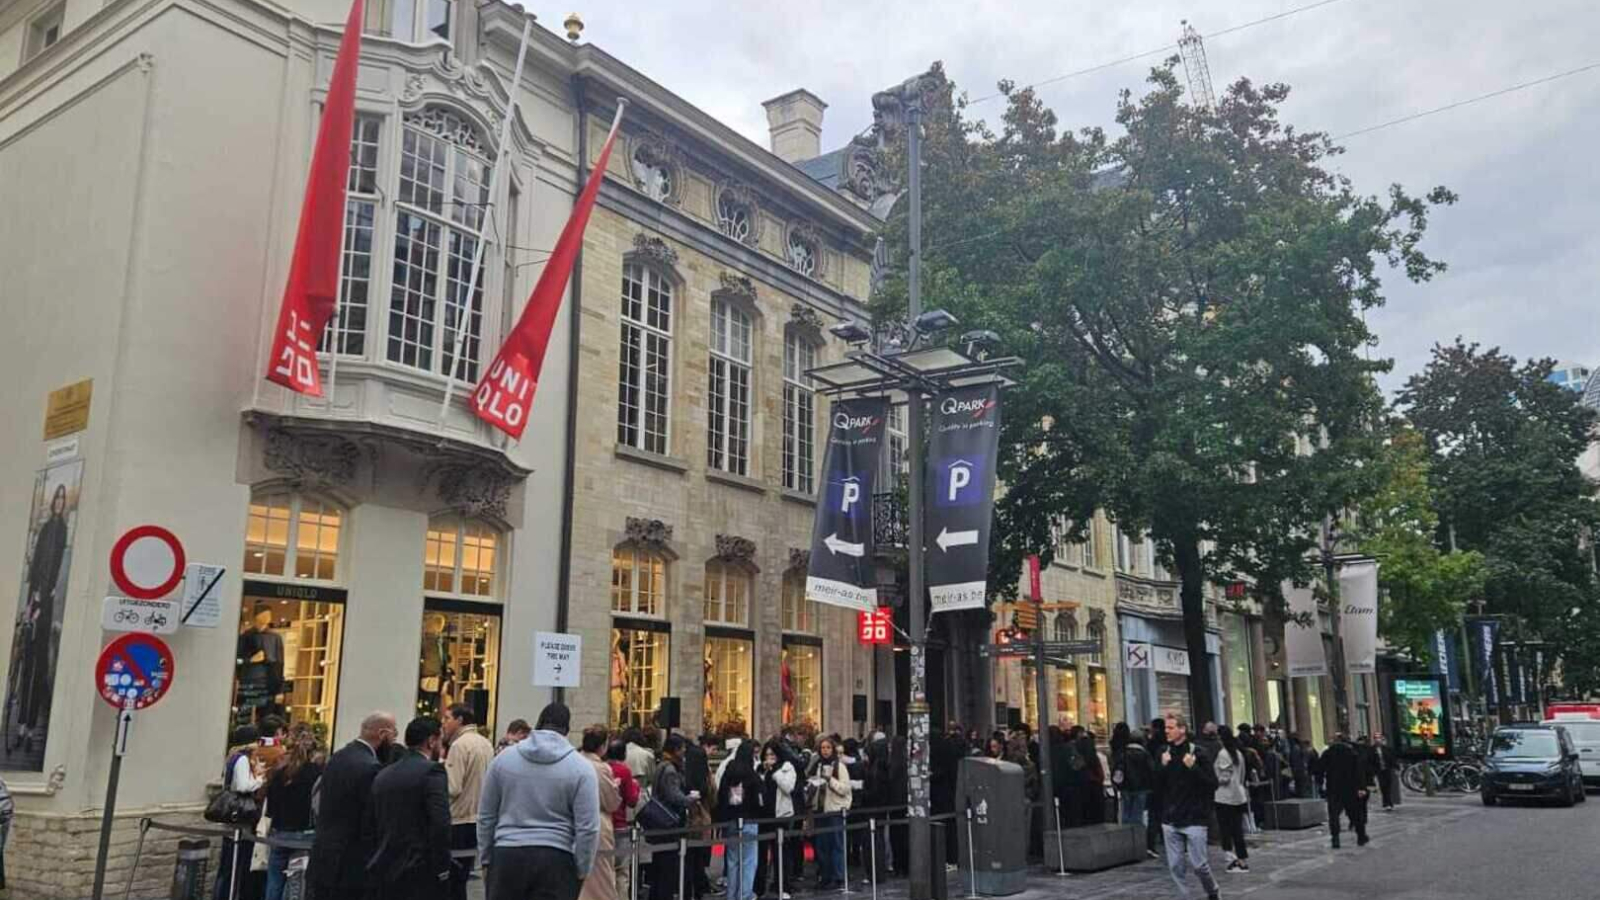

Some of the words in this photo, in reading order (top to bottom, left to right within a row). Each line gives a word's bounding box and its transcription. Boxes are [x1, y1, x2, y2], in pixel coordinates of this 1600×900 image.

[490, 358, 529, 400] UNI
[475, 384, 523, 427] QLO
[948, 466, 971, 501] P
[841, 481, 860, 513] P
[276, 585, 318, 599] UNIQLO
[814, 583, 869, 602] meir-asbe
[932, 589, 983, 606] meir-asbe
[1344, 604, 1374, 615] Etam
[559, 653, 570, 661] WAY
